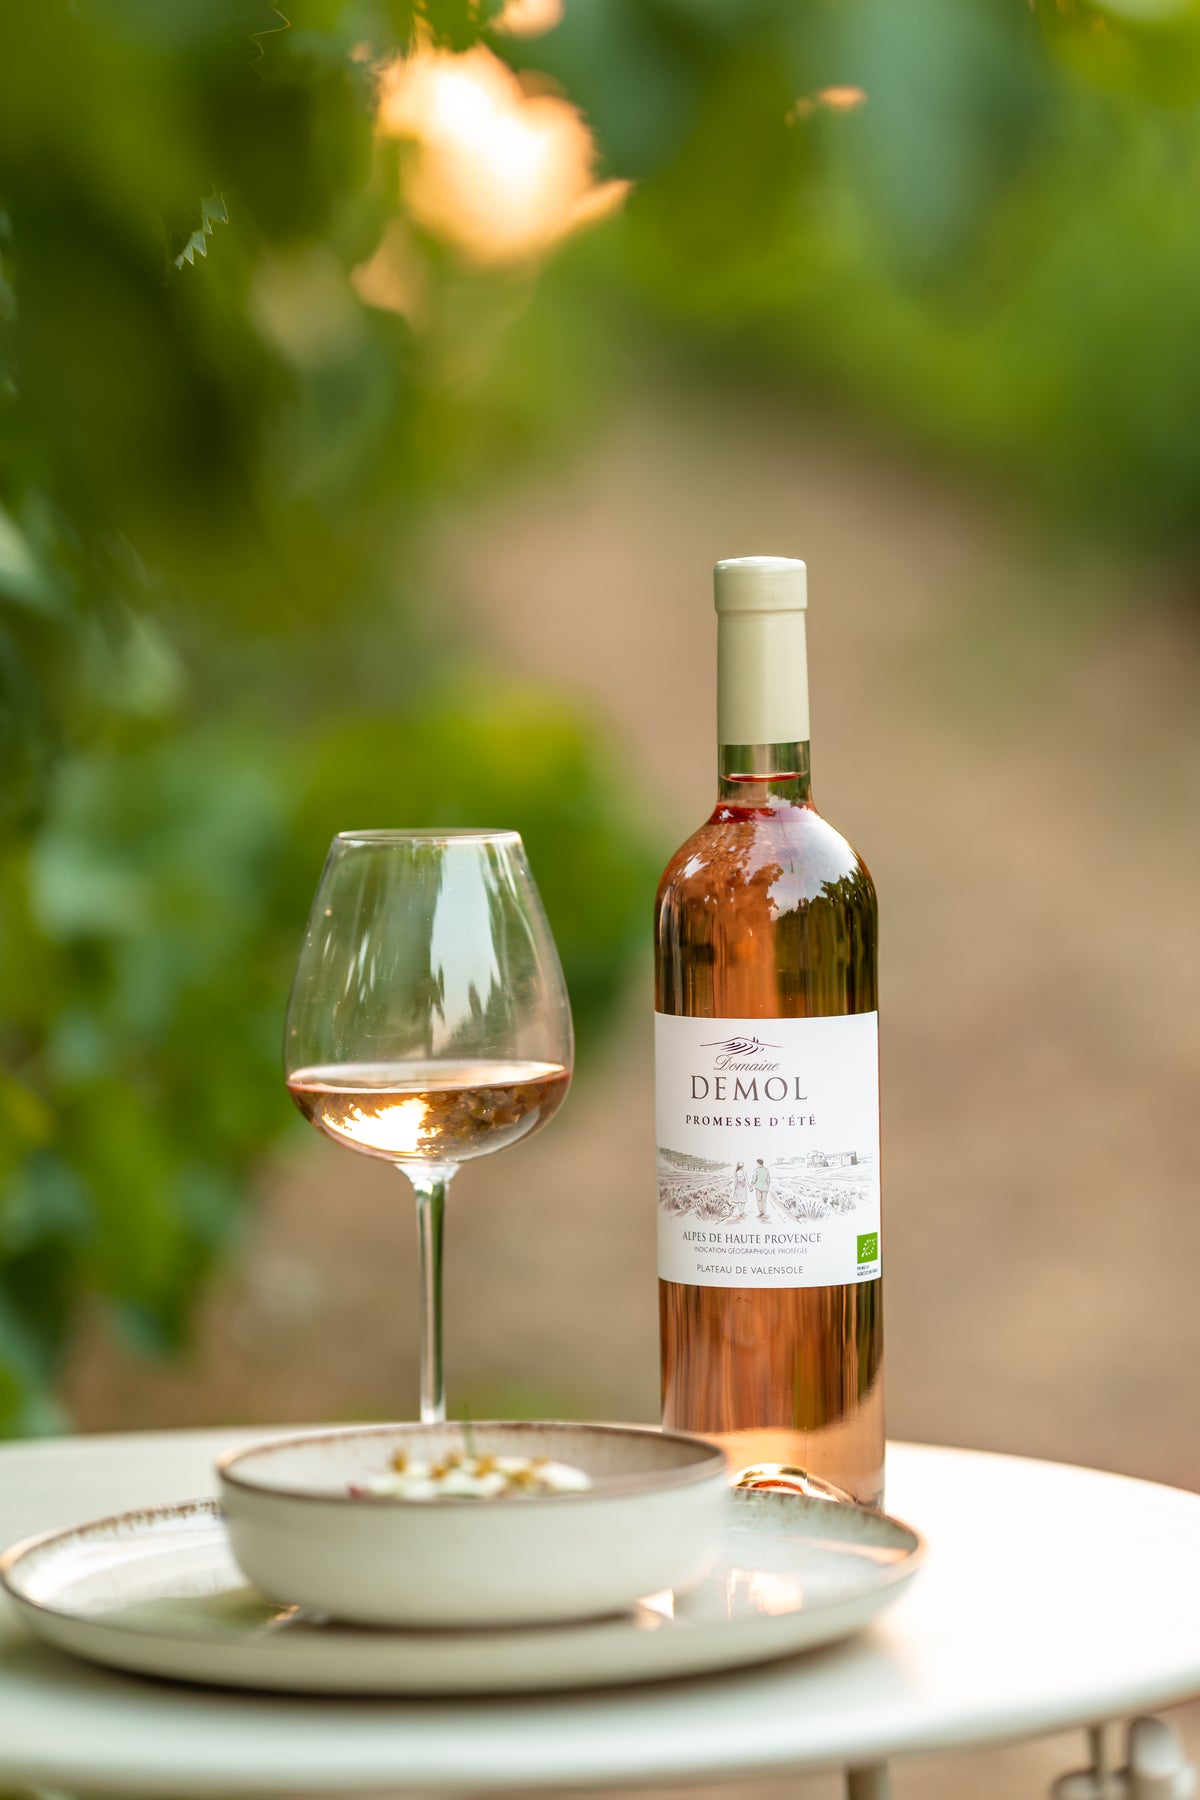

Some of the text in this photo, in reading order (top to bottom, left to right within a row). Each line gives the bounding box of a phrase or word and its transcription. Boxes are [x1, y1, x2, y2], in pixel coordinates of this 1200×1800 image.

[713, 1054, 780, 1072] Domaine
[690, 1075, 808, 1101] DEMOL
[685, 1113, 817, 1127] PROMESSE D'ÉTÉ
[682, 1231, 822, 1244] ALPES DE HAUTE PROVENCE
[694, 1246, 727, 1254] INDICATION
[697, 1264, 804, 1275] PLATEAU DE VALENSOLE
